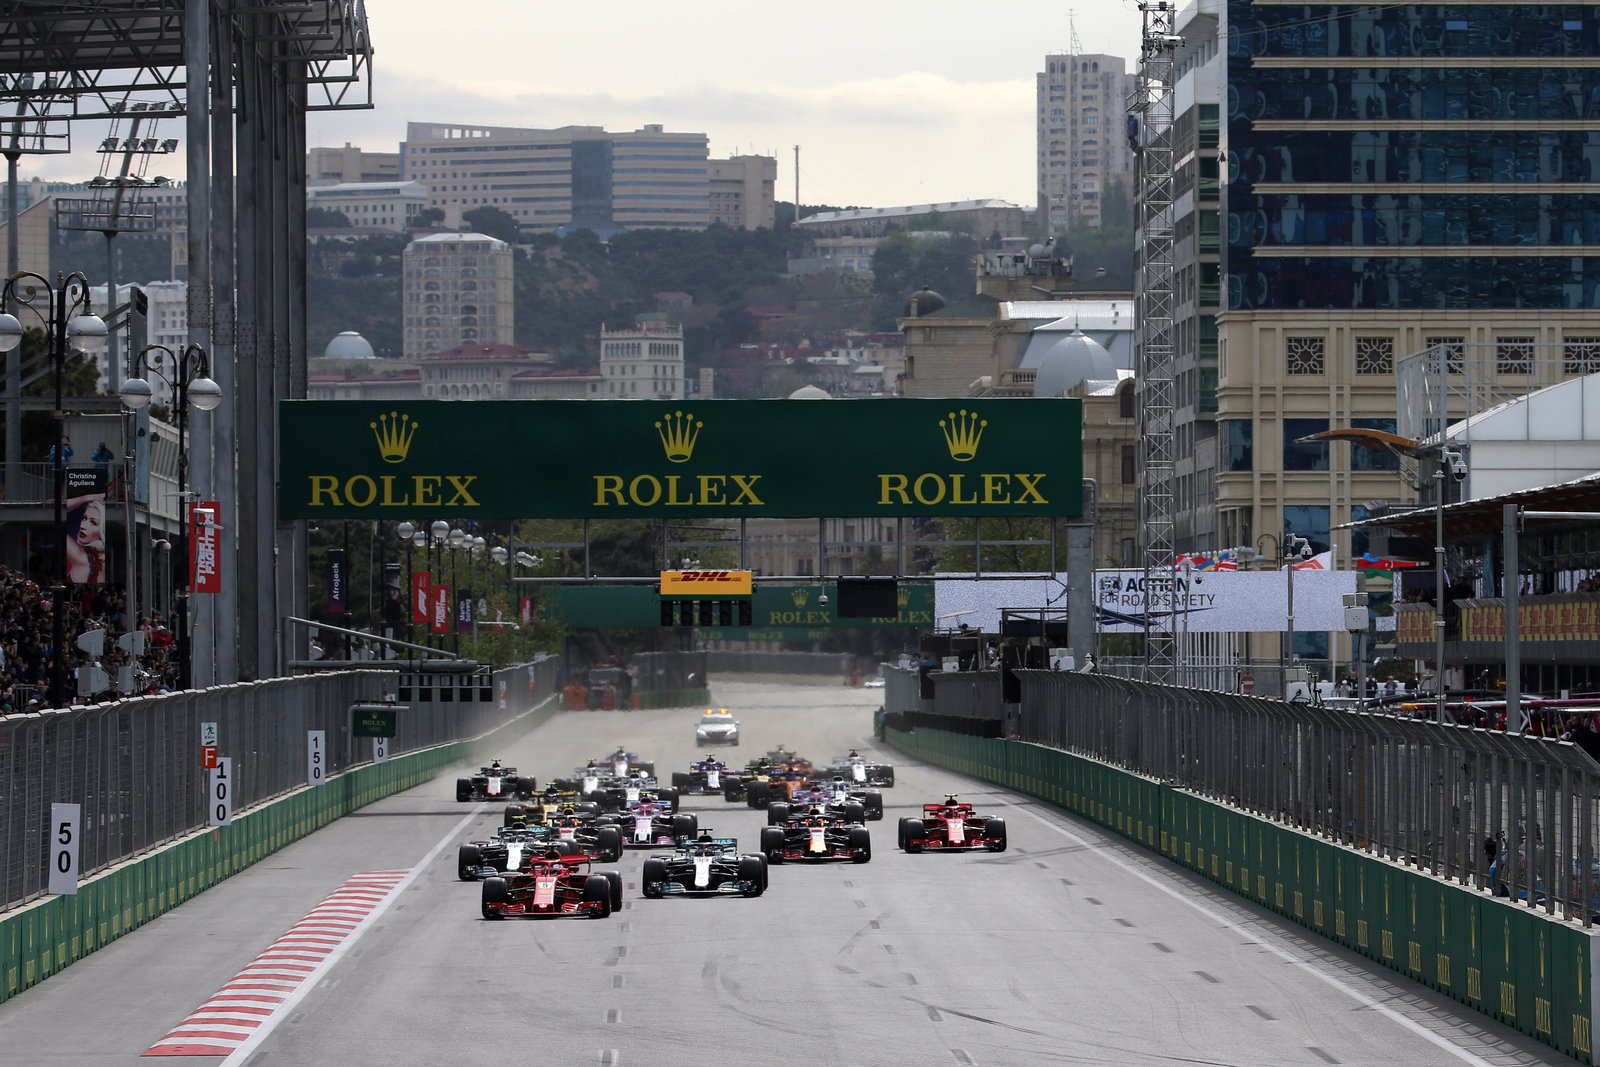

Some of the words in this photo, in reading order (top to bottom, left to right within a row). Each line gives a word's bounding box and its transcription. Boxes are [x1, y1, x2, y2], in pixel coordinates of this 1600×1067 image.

[307, 474, 481, 507] ROLEX
[592, 474, 765, 506] ROLEX
[876, 473, 1049, 505] ROLEX
[332, 562, 341, 600] Afrojack
[680, 571, 733, 582] DHL
[769, 611, 832, 624] ROLEX
[205, 748, 216, 767] F
[311, 736, 321, 780] 150
[216, 761, 227, 821] 100
[57, 822, 72, 873] 50
[1535, 997, 1552, 1034] ROLEX
[1572, 1014, 1590, 1053] ROLEX
